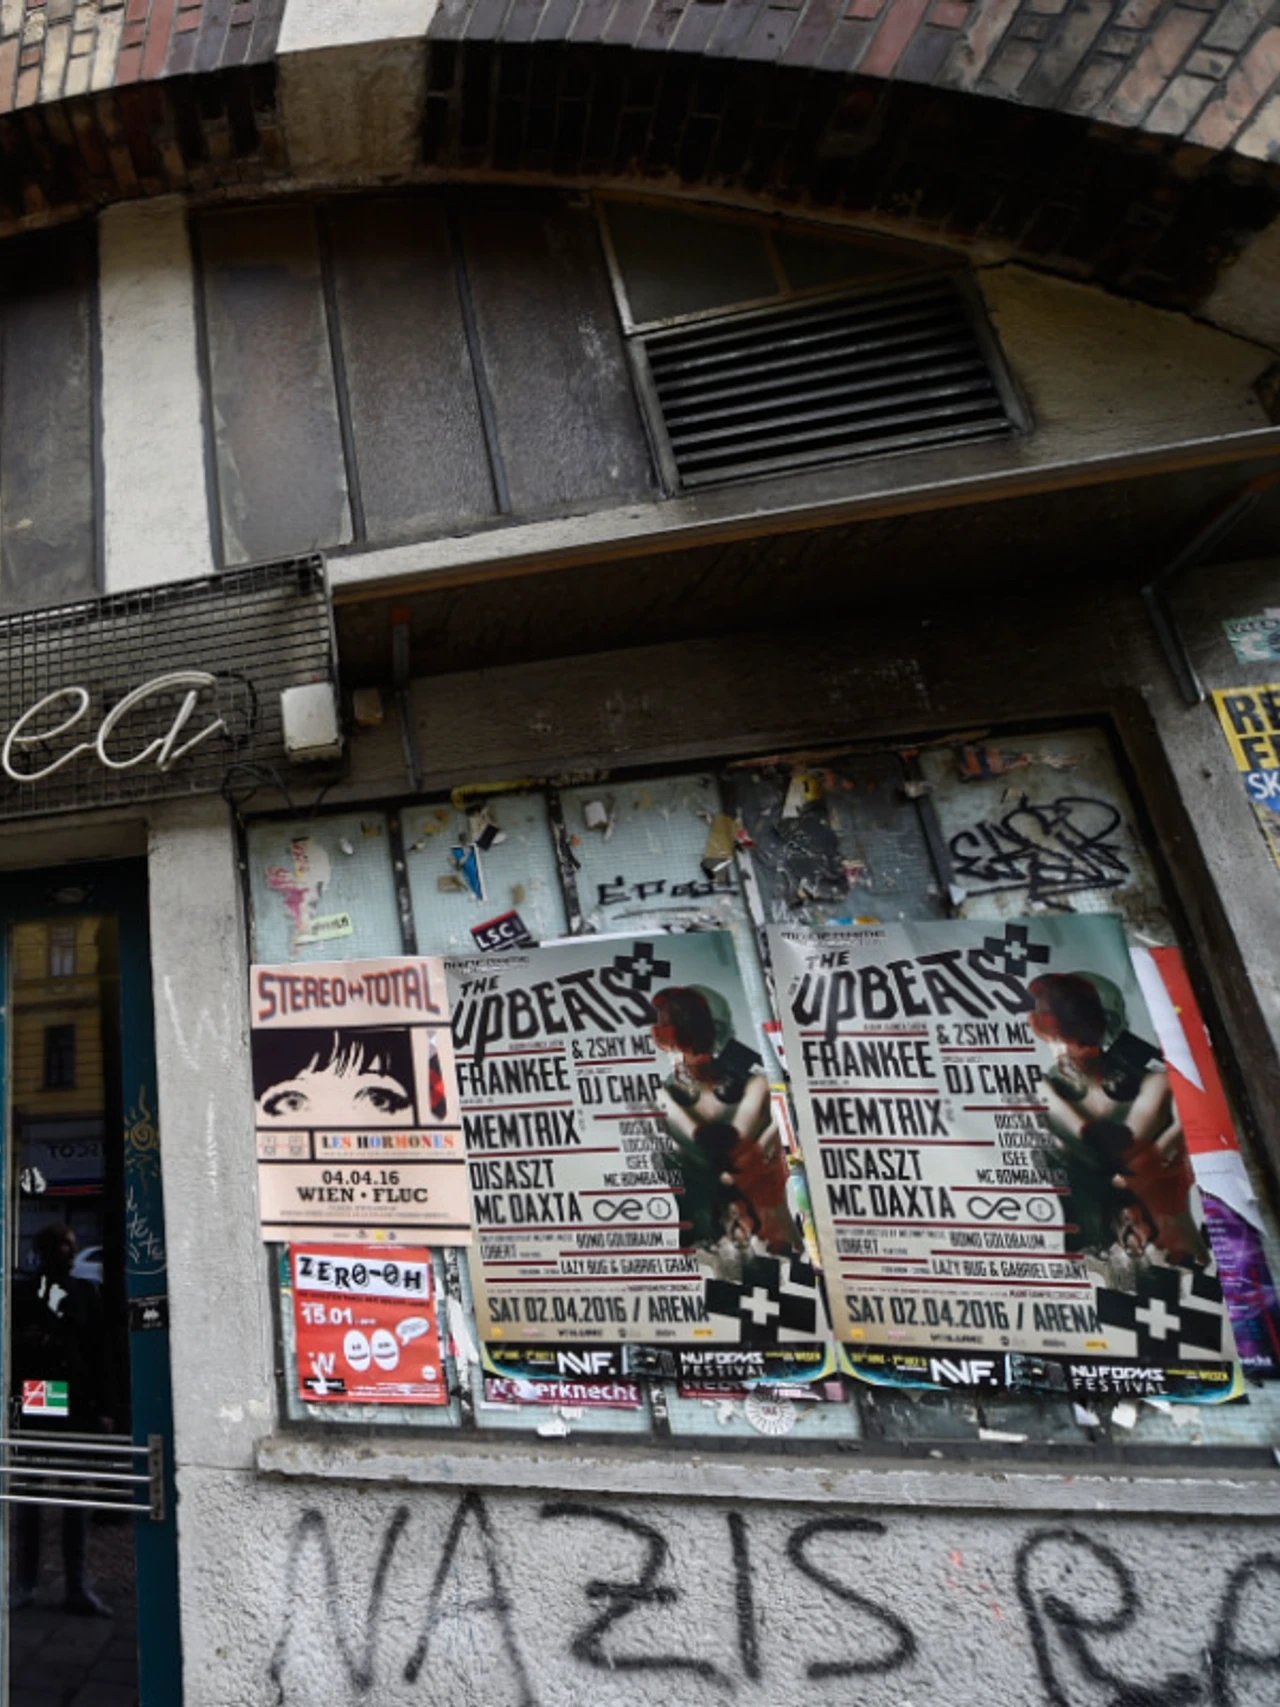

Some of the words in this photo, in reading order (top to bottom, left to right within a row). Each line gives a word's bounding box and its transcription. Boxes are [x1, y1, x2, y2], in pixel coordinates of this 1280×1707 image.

[476, 922, 515, 951] LSC
[806, 951, 850, 969] THE
[258, 971, 347, 1021] STEREO
[362, 963, 440, 1016] TOTAL
[460, 975, 500, 997] THE
[791, 949, 1036, 1045] UPBEATS
[451, 967, 659, 1065] UPBEATS
[586, 1036, 628, 1056] 2SHY
[633, 1034, 656, 1055] MC
[955, 1022, 999, 1045] 2SHY
[1008, 1022, 1035, 1044] MC
[802, 1041, 936, 1079] FRANKEE
[456, 1056, 570, 1096] FRANKEE
[577, 1077, 603, 1105] DJ
[607, 1073, 662, 1103] CHAP
[944, 1065, 971, 1094] DJ
[979, 1064, 1043, 1094] CHAP
[463, 1109, 581, 1150] MEMTRIX
[812, 1098, 949, 1136] MEMTRIX
[322, 1134, 352, 1149] LES
[357, 1134, 454, 1149] HORMONES
[322, 1171, 400, 1186] 04.04.16
[469, 1159, 554, 1190] DISASZT
[820, 1148, 922, 1181] DISASZT
[297, 1187, 355, 1203] WIEN
[373, 1187, 428, 1203] FLUC
[473, 1195, 506, 1225] MC
[511, 1192, 583, 1223] DAXTA
[827, 1184, 866, 1217] MC
[873, 1185, 956, 1219] DAXTA
[489, 1297, 521, 1323] SAT
[524, 1297, 627, 1323] 02.04.2016
[647, 1296, 710, 1323] ARENA
[845, 1295, 886, 1323] SAT
[890, 1296, 1009, 1330] 02.04.2016
[1033, 1302, 1104, 1333] ARENA
[683, 1365, 766, 1378] FESTIVAL
[1073, 1378, 1169, 1394] FESTIVAL
[268, 1492, 918, 1707] NAZIS
